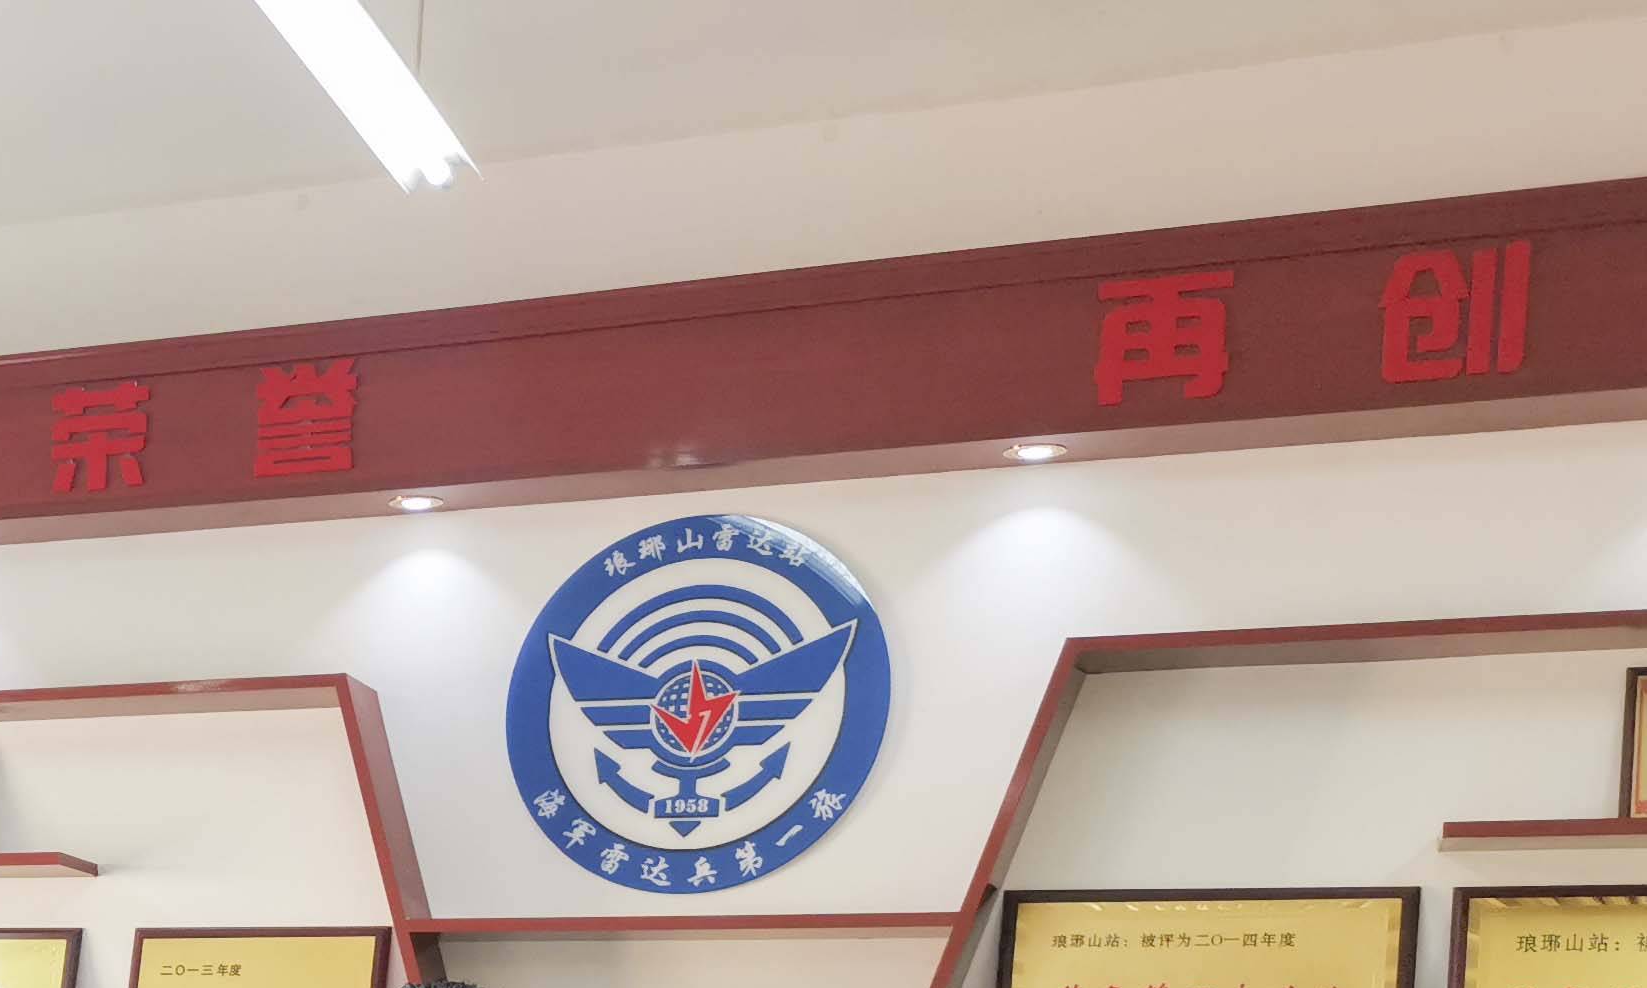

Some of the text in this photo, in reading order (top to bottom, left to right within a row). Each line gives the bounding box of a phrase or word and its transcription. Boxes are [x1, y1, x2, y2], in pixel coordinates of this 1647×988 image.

[1094, 241, 1532, 405] 再创
[604, 522, 807, 577] 琅琊山雷达站
[533, 788, 847, 888] 海军雷达兵第一旅
[664, 799, 710, 814] 1958
